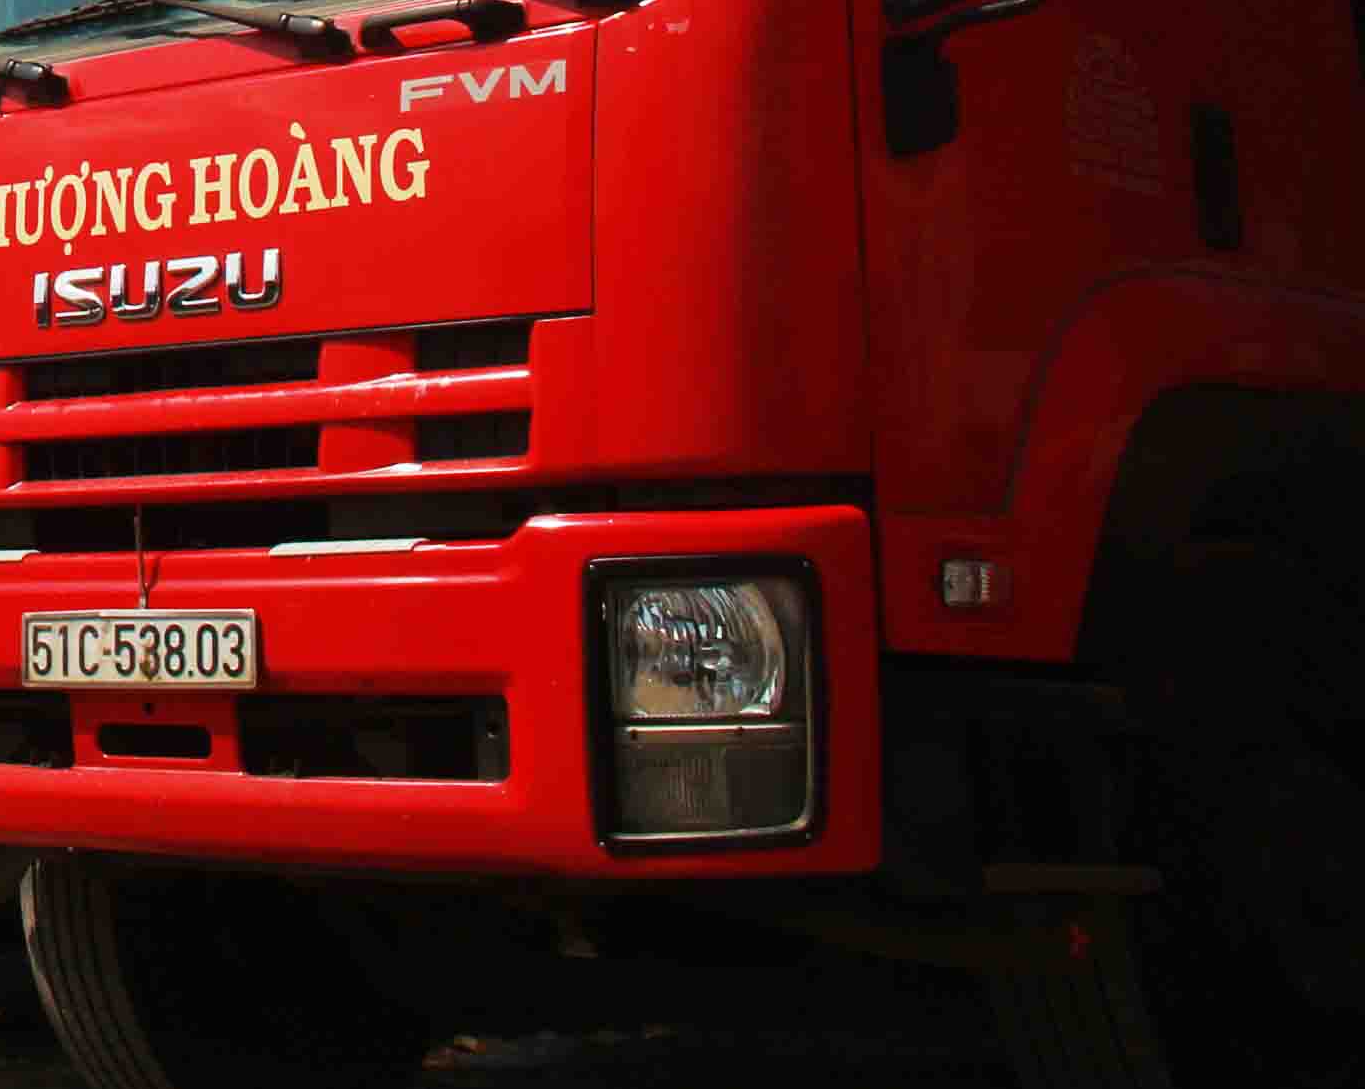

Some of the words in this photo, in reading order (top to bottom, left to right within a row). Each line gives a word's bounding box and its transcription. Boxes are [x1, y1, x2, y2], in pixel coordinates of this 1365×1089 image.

[399, 59, 566, 113] FVM
[189, 122, 429, 226] HOÀNG
[31, 248, 284, 329] ISUZU
[31, 622, 246, 679] 51C-538.03
